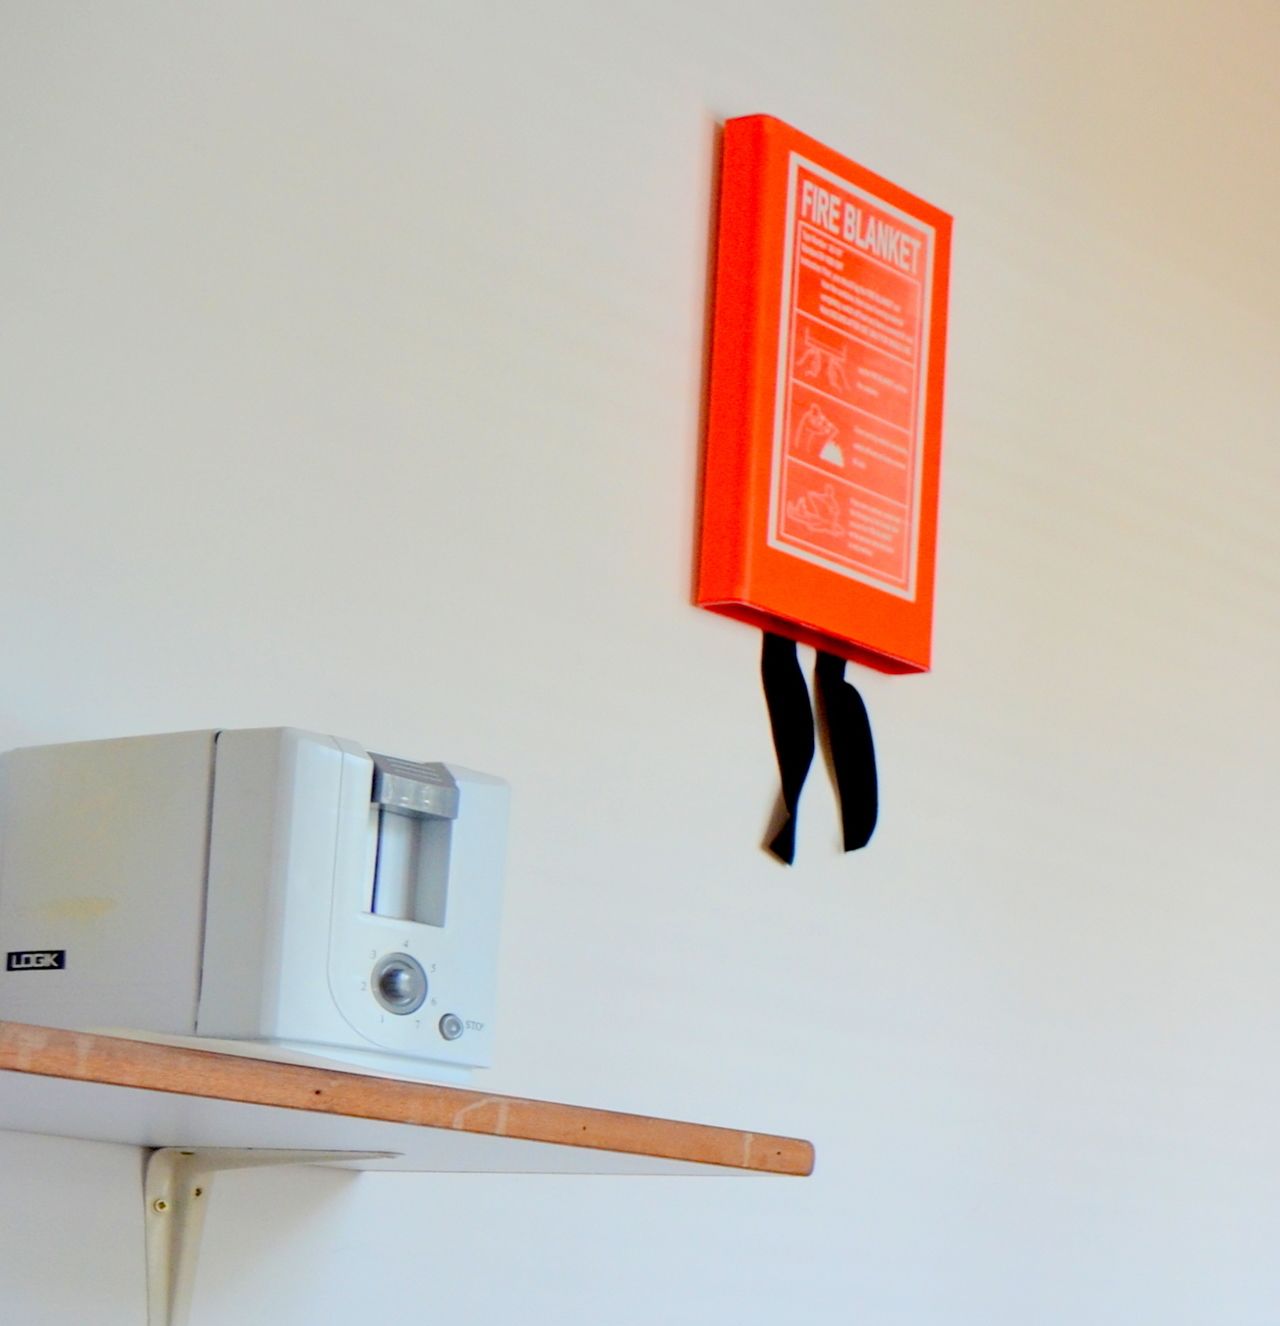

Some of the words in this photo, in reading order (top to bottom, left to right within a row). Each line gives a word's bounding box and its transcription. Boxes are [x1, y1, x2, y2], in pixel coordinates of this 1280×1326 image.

[801, 179, 841, 234] FIRE
[843, 202, 923, 274] BLANKET
[11, 953, 59, 969] LOGIK
